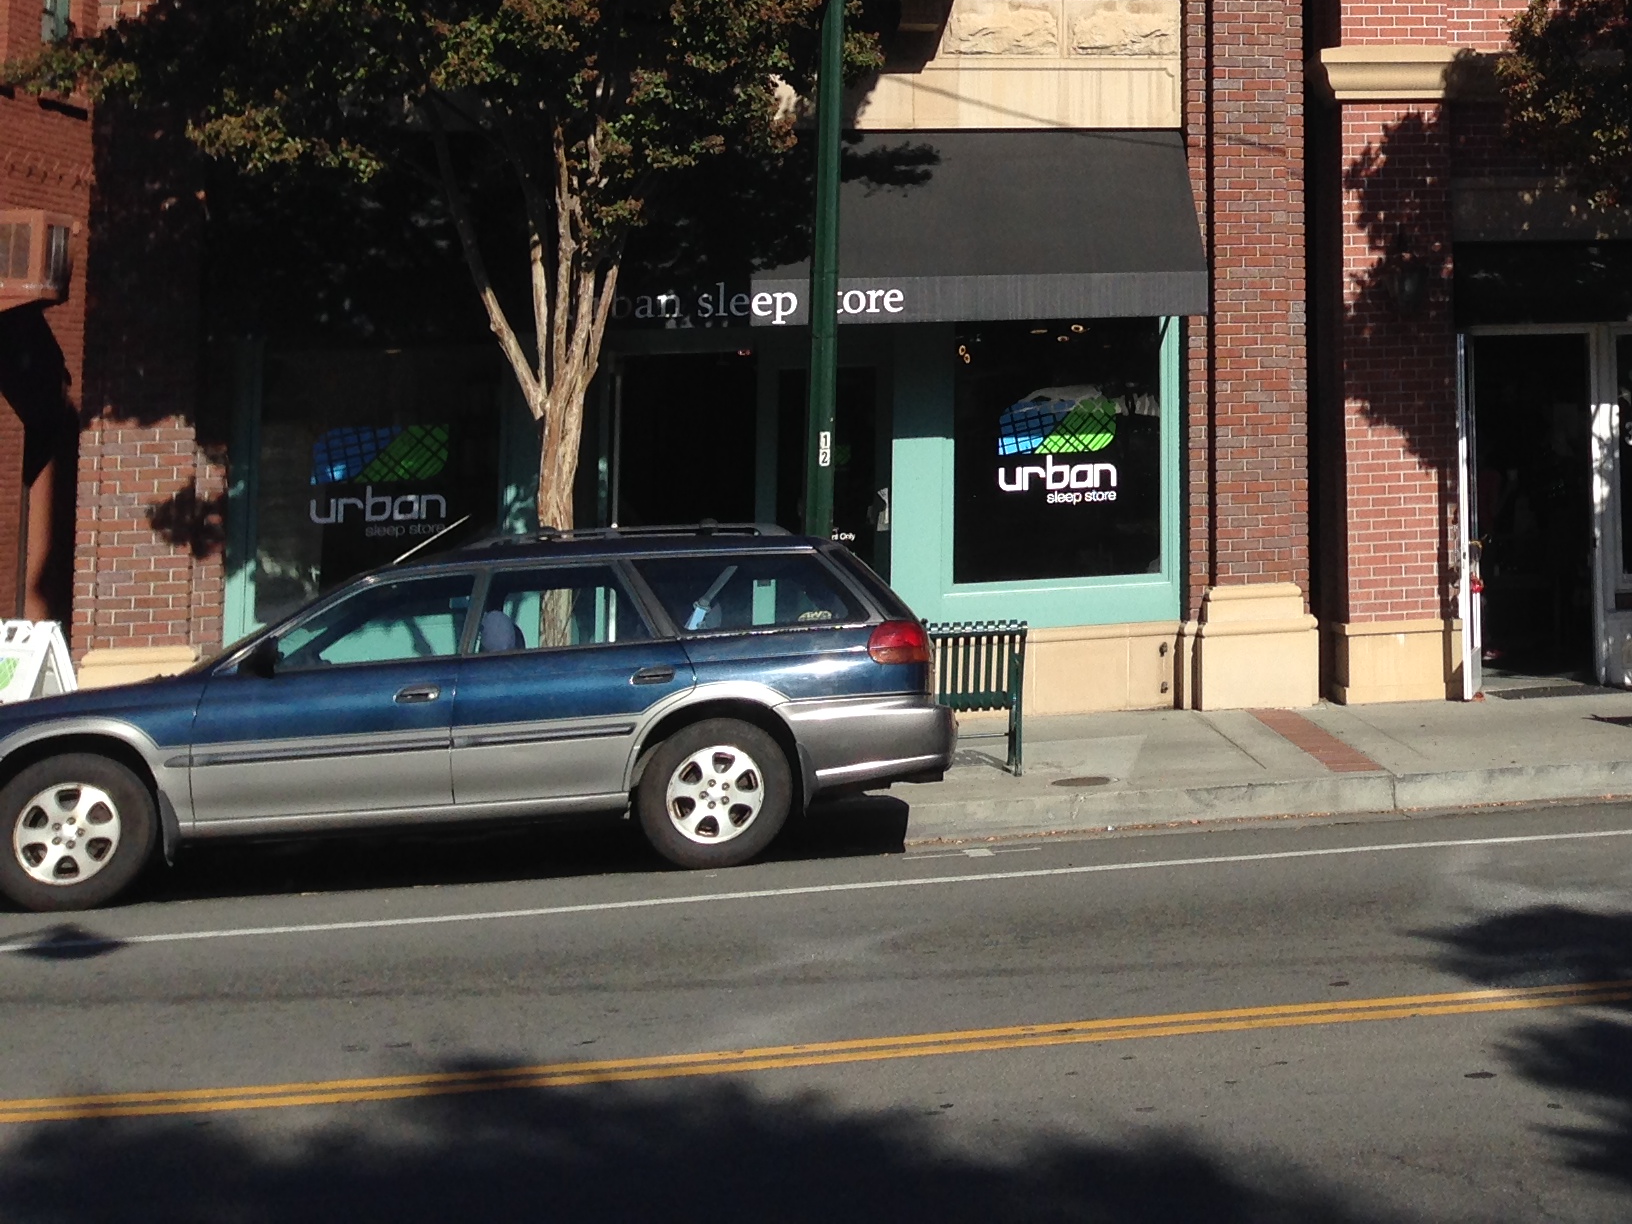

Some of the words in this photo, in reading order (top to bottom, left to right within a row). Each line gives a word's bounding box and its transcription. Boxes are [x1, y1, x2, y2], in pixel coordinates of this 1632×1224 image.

[697, 281, 799, 325] sleep
[998, 454, 1117, 492] urban
[309, 485, 447, 524] urban
[1046, 490, 1082, 506] sleep
[1084, 489, 1117, 503] store
[365, 523, 406, 538] sleep
[409, 522, 446, 535] store
